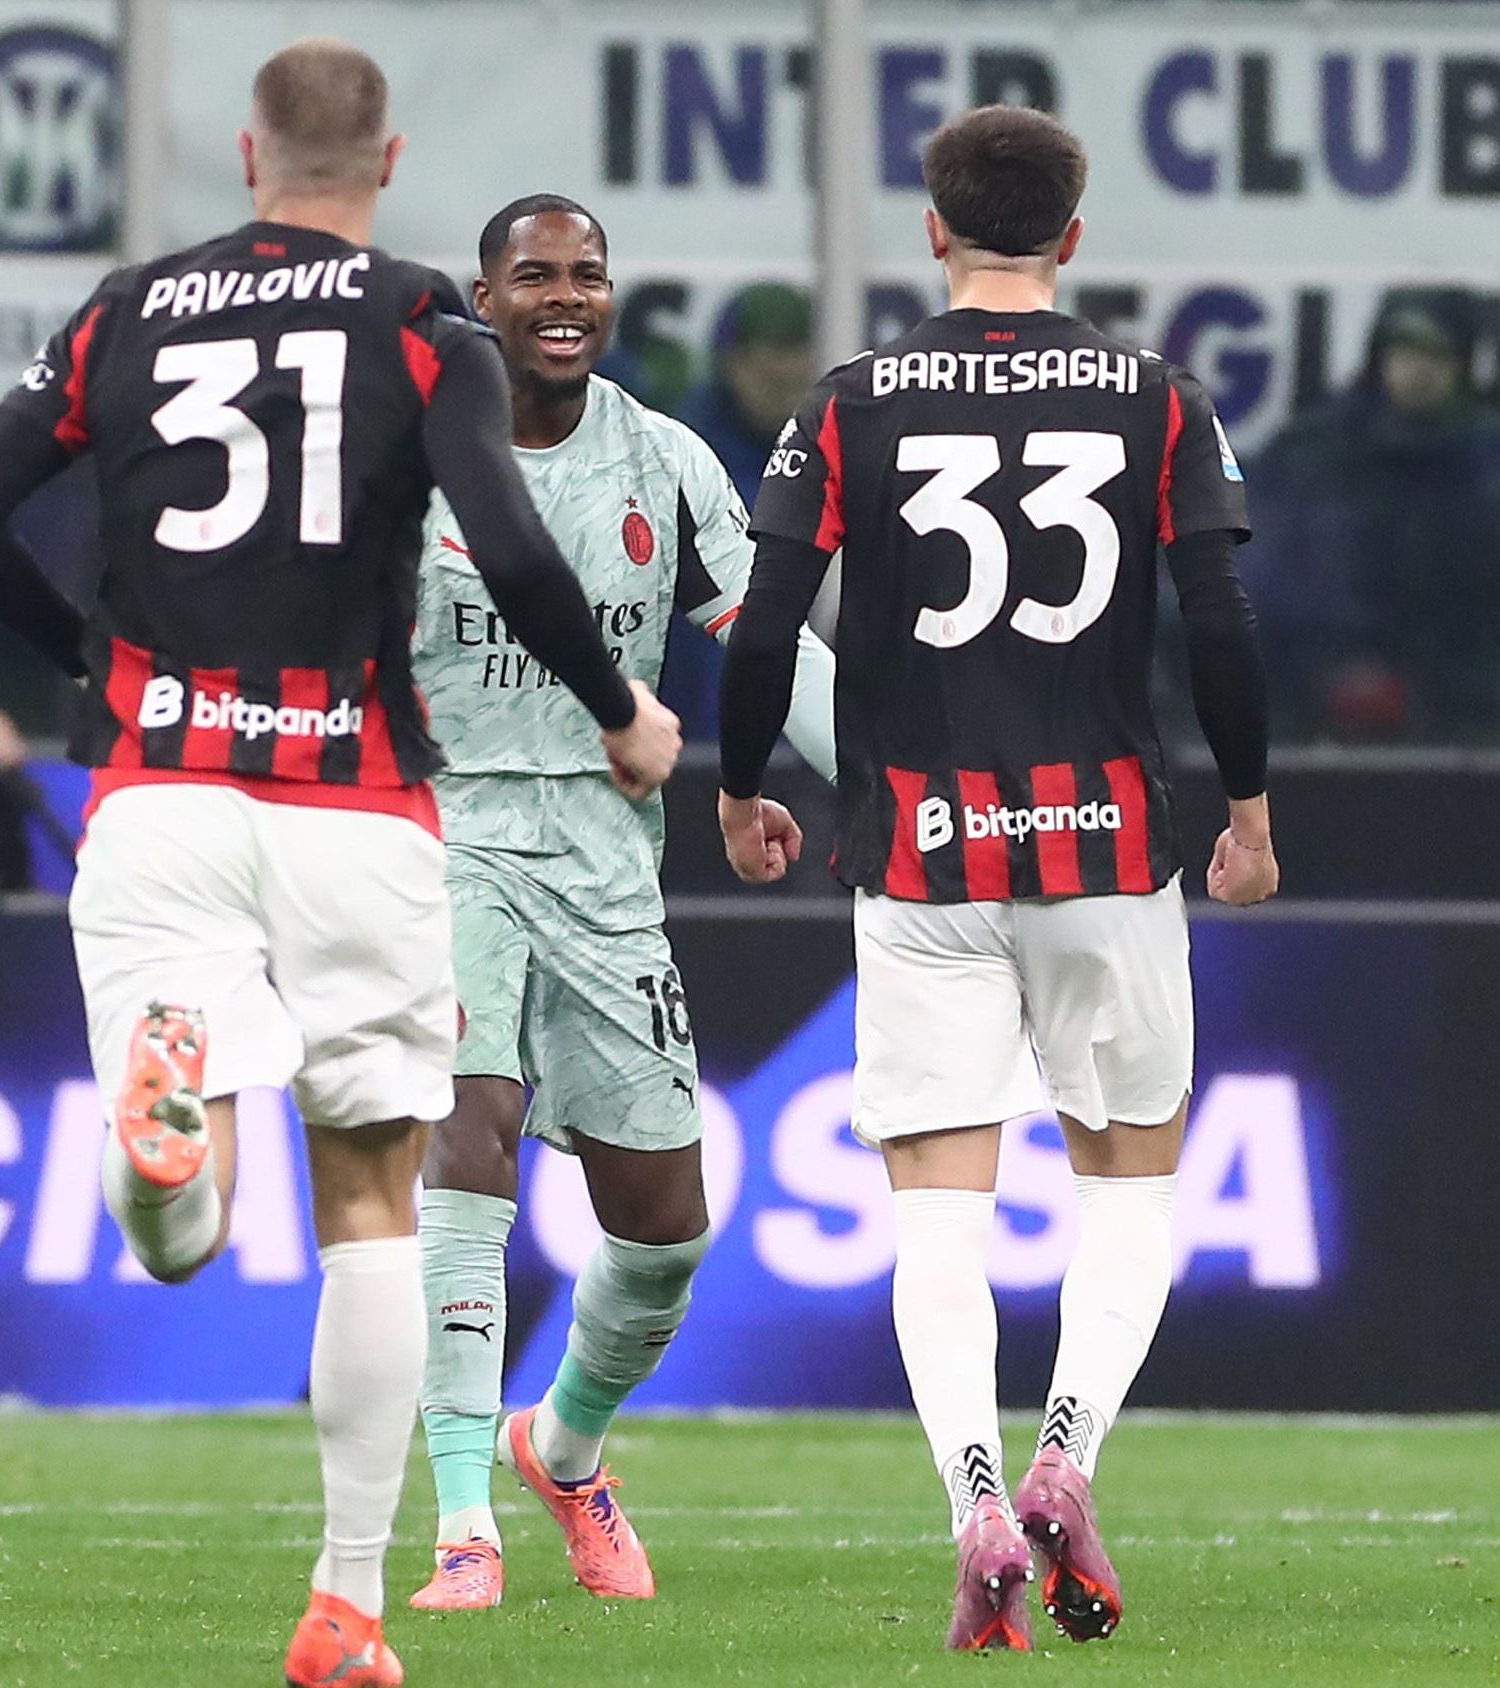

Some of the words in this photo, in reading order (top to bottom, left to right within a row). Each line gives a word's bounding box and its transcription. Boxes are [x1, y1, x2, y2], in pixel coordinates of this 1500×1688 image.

[1141, 48, 1500, 196] CLUB
[140, 252, 371, 320] PAVLOVIĆ
[872, 348, 1140, 398] BARTESAGHI
[151, 328, 348, 553] 31
[896, 430, 1127, 649] 33
[453, 599, 646, 646] Etes
[483, 653, 531, 689] FLY
[963, 801, 1122, 844] bitpanda
[635, 969, 691, 1053] 16
[414, 1070, 1321, 1290] OSA
